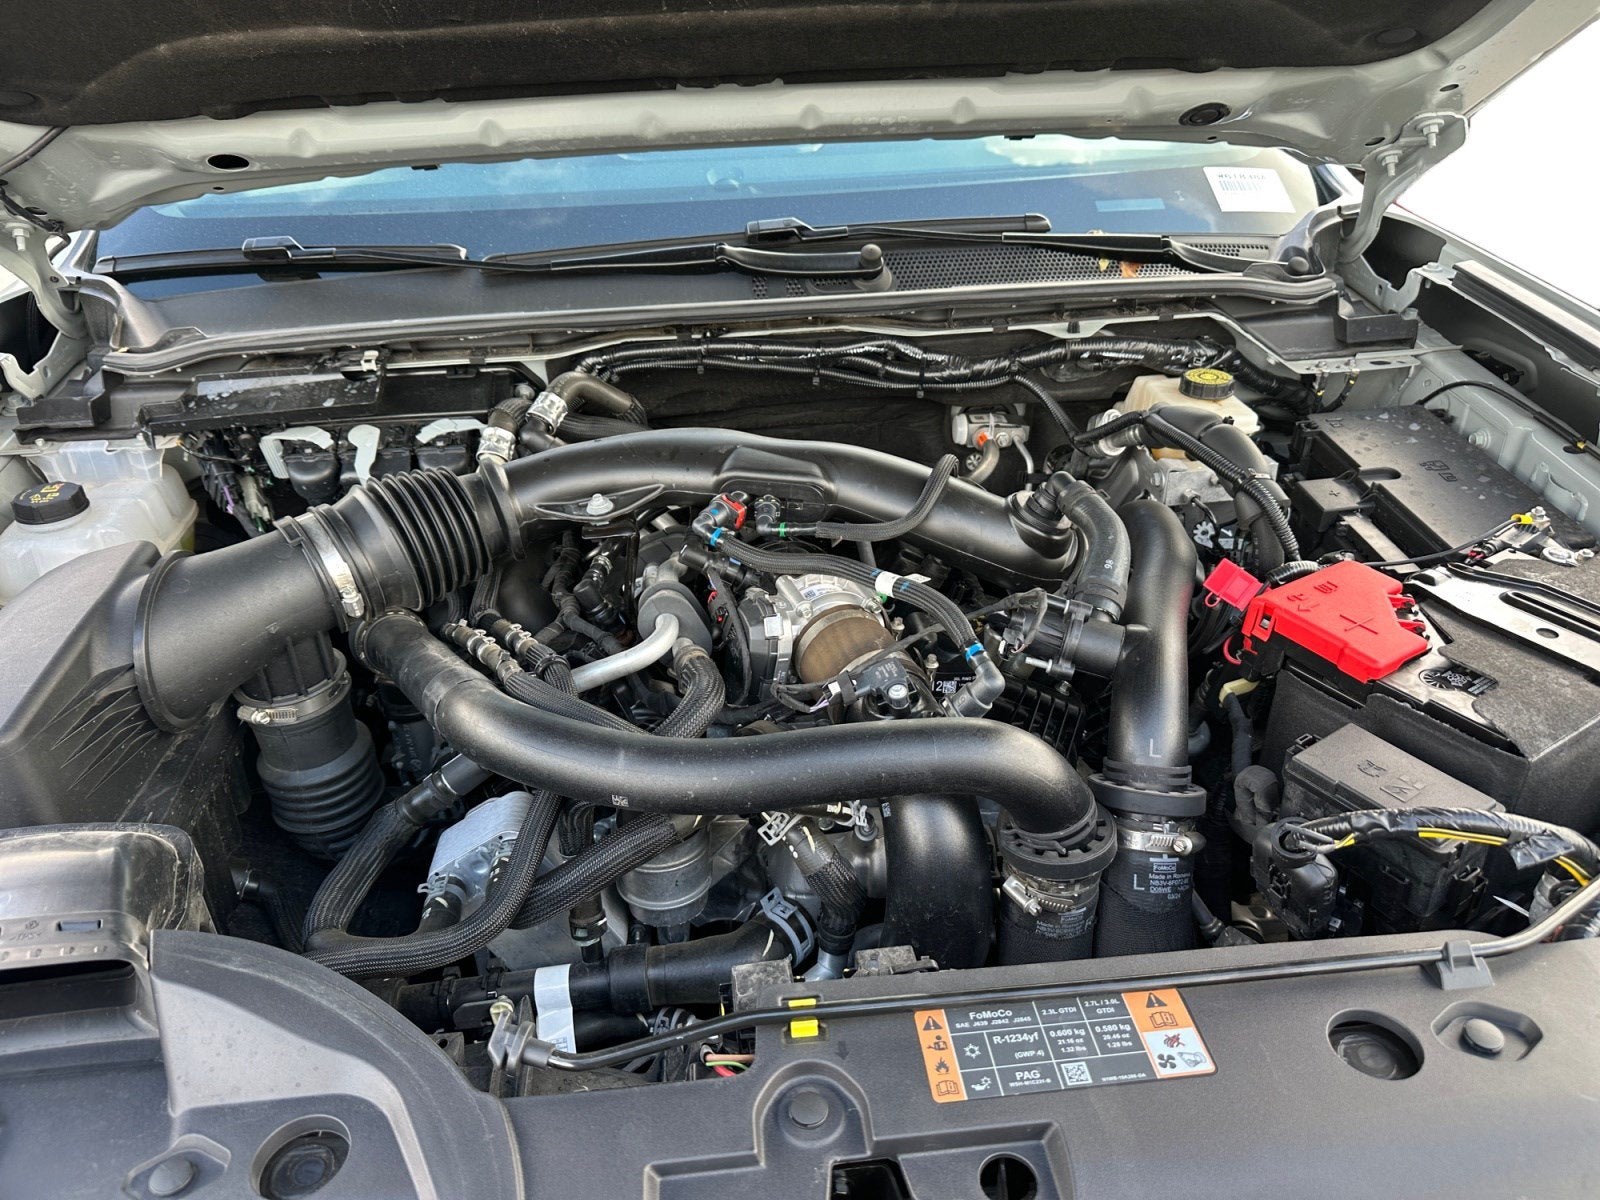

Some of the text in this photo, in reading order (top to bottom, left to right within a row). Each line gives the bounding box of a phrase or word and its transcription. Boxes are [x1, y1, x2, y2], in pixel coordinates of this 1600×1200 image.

[1150, 738, 1162, 758] L
[1134, 874, 1145, 890] L
[969, 1009, 1012, 1019] FoMoCo
[1095, 1024, 1118, 1032] 0.580
[992, 1032, 1039, 1044] R-1234yf
[1015, 1070, 1041, 1080] PAG
